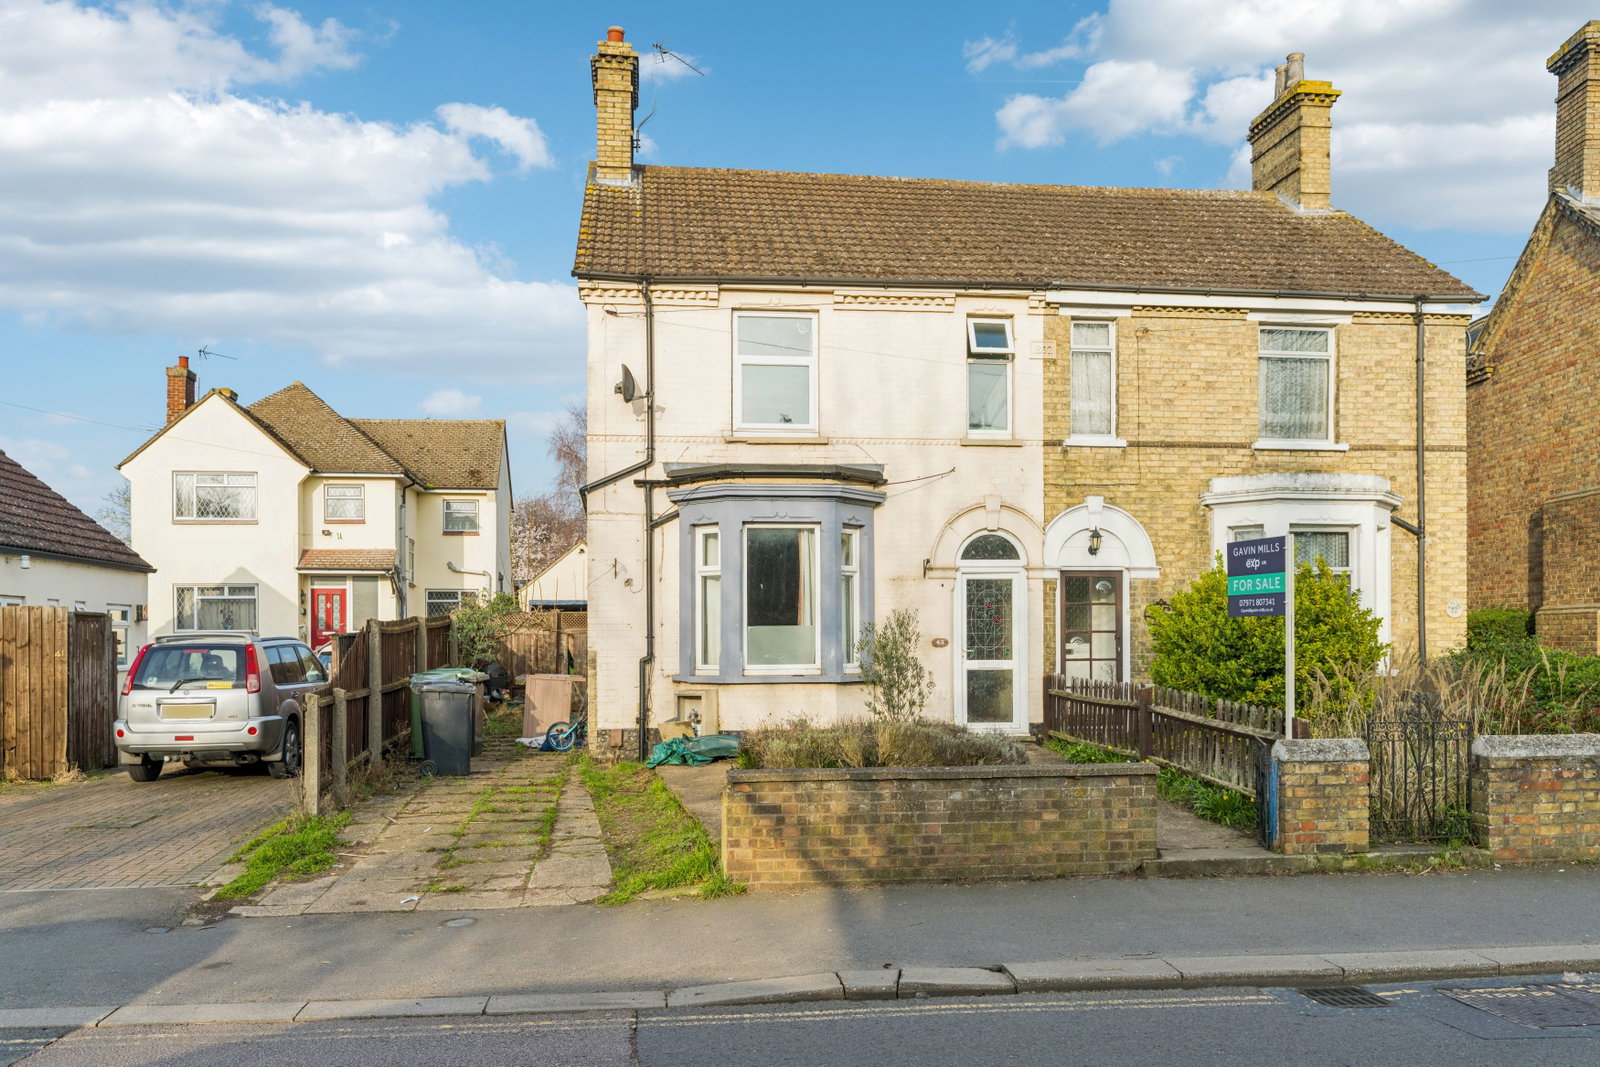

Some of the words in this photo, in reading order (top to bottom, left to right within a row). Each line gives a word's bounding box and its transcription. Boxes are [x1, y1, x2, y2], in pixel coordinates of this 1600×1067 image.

[1233, 546, 1255, 556] GAVIN
[1257, 543, 1279, 554] MILLS
[1246, 558, 1260, 570] exp
[1233, 580, 1252, 591] FOR
[1256, 577, 1280, 590] SALE
[1239, 599, 1255, 607] 07971
